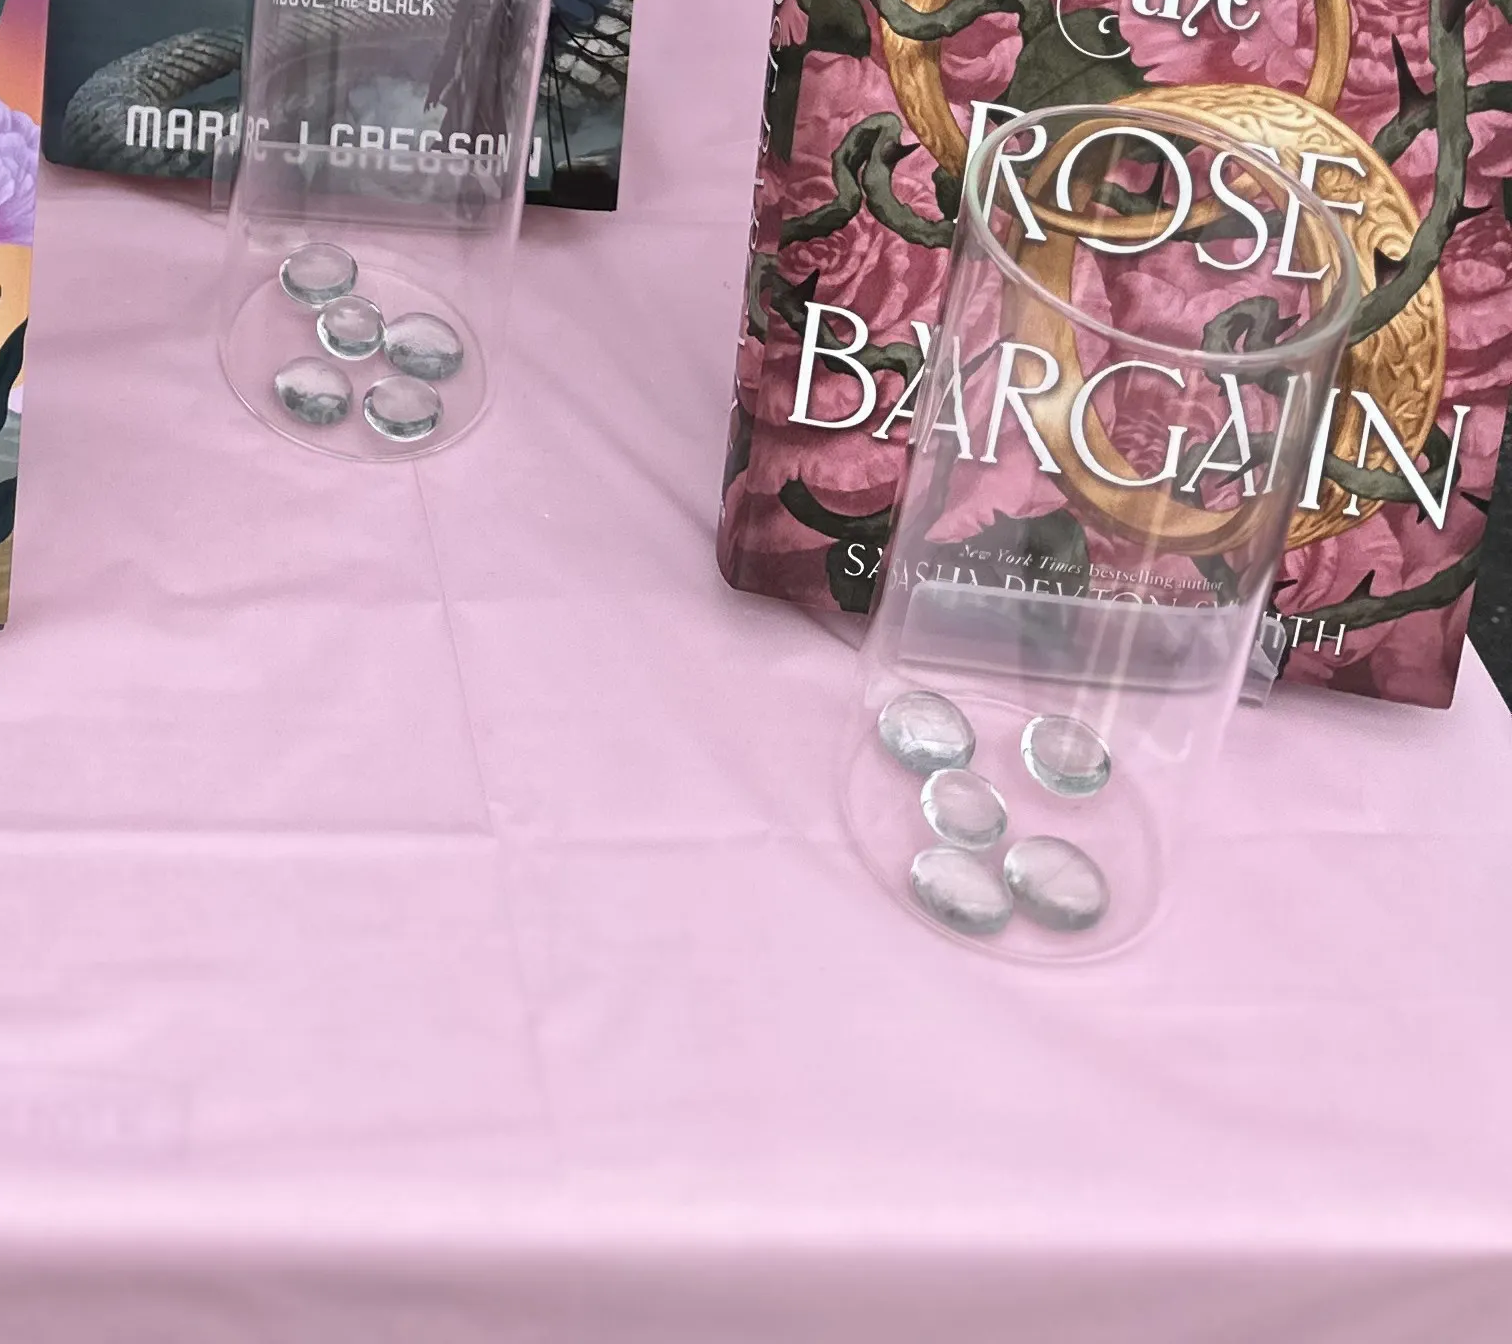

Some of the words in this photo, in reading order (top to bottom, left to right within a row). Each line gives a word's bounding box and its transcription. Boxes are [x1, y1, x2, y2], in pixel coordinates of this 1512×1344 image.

[283, 120, 310, 164] J
[952, 100, 1368, 282] ROSE
[788, 301, 1471, 531] BARGAIN
[959, 543, 993, 562] New
[997, 547, 1034, 568] York
[1039, 554, 1083, 576] Times
[1088, 563, 1175, 591] bestselling
[1177, 577, 1225, 593] author
